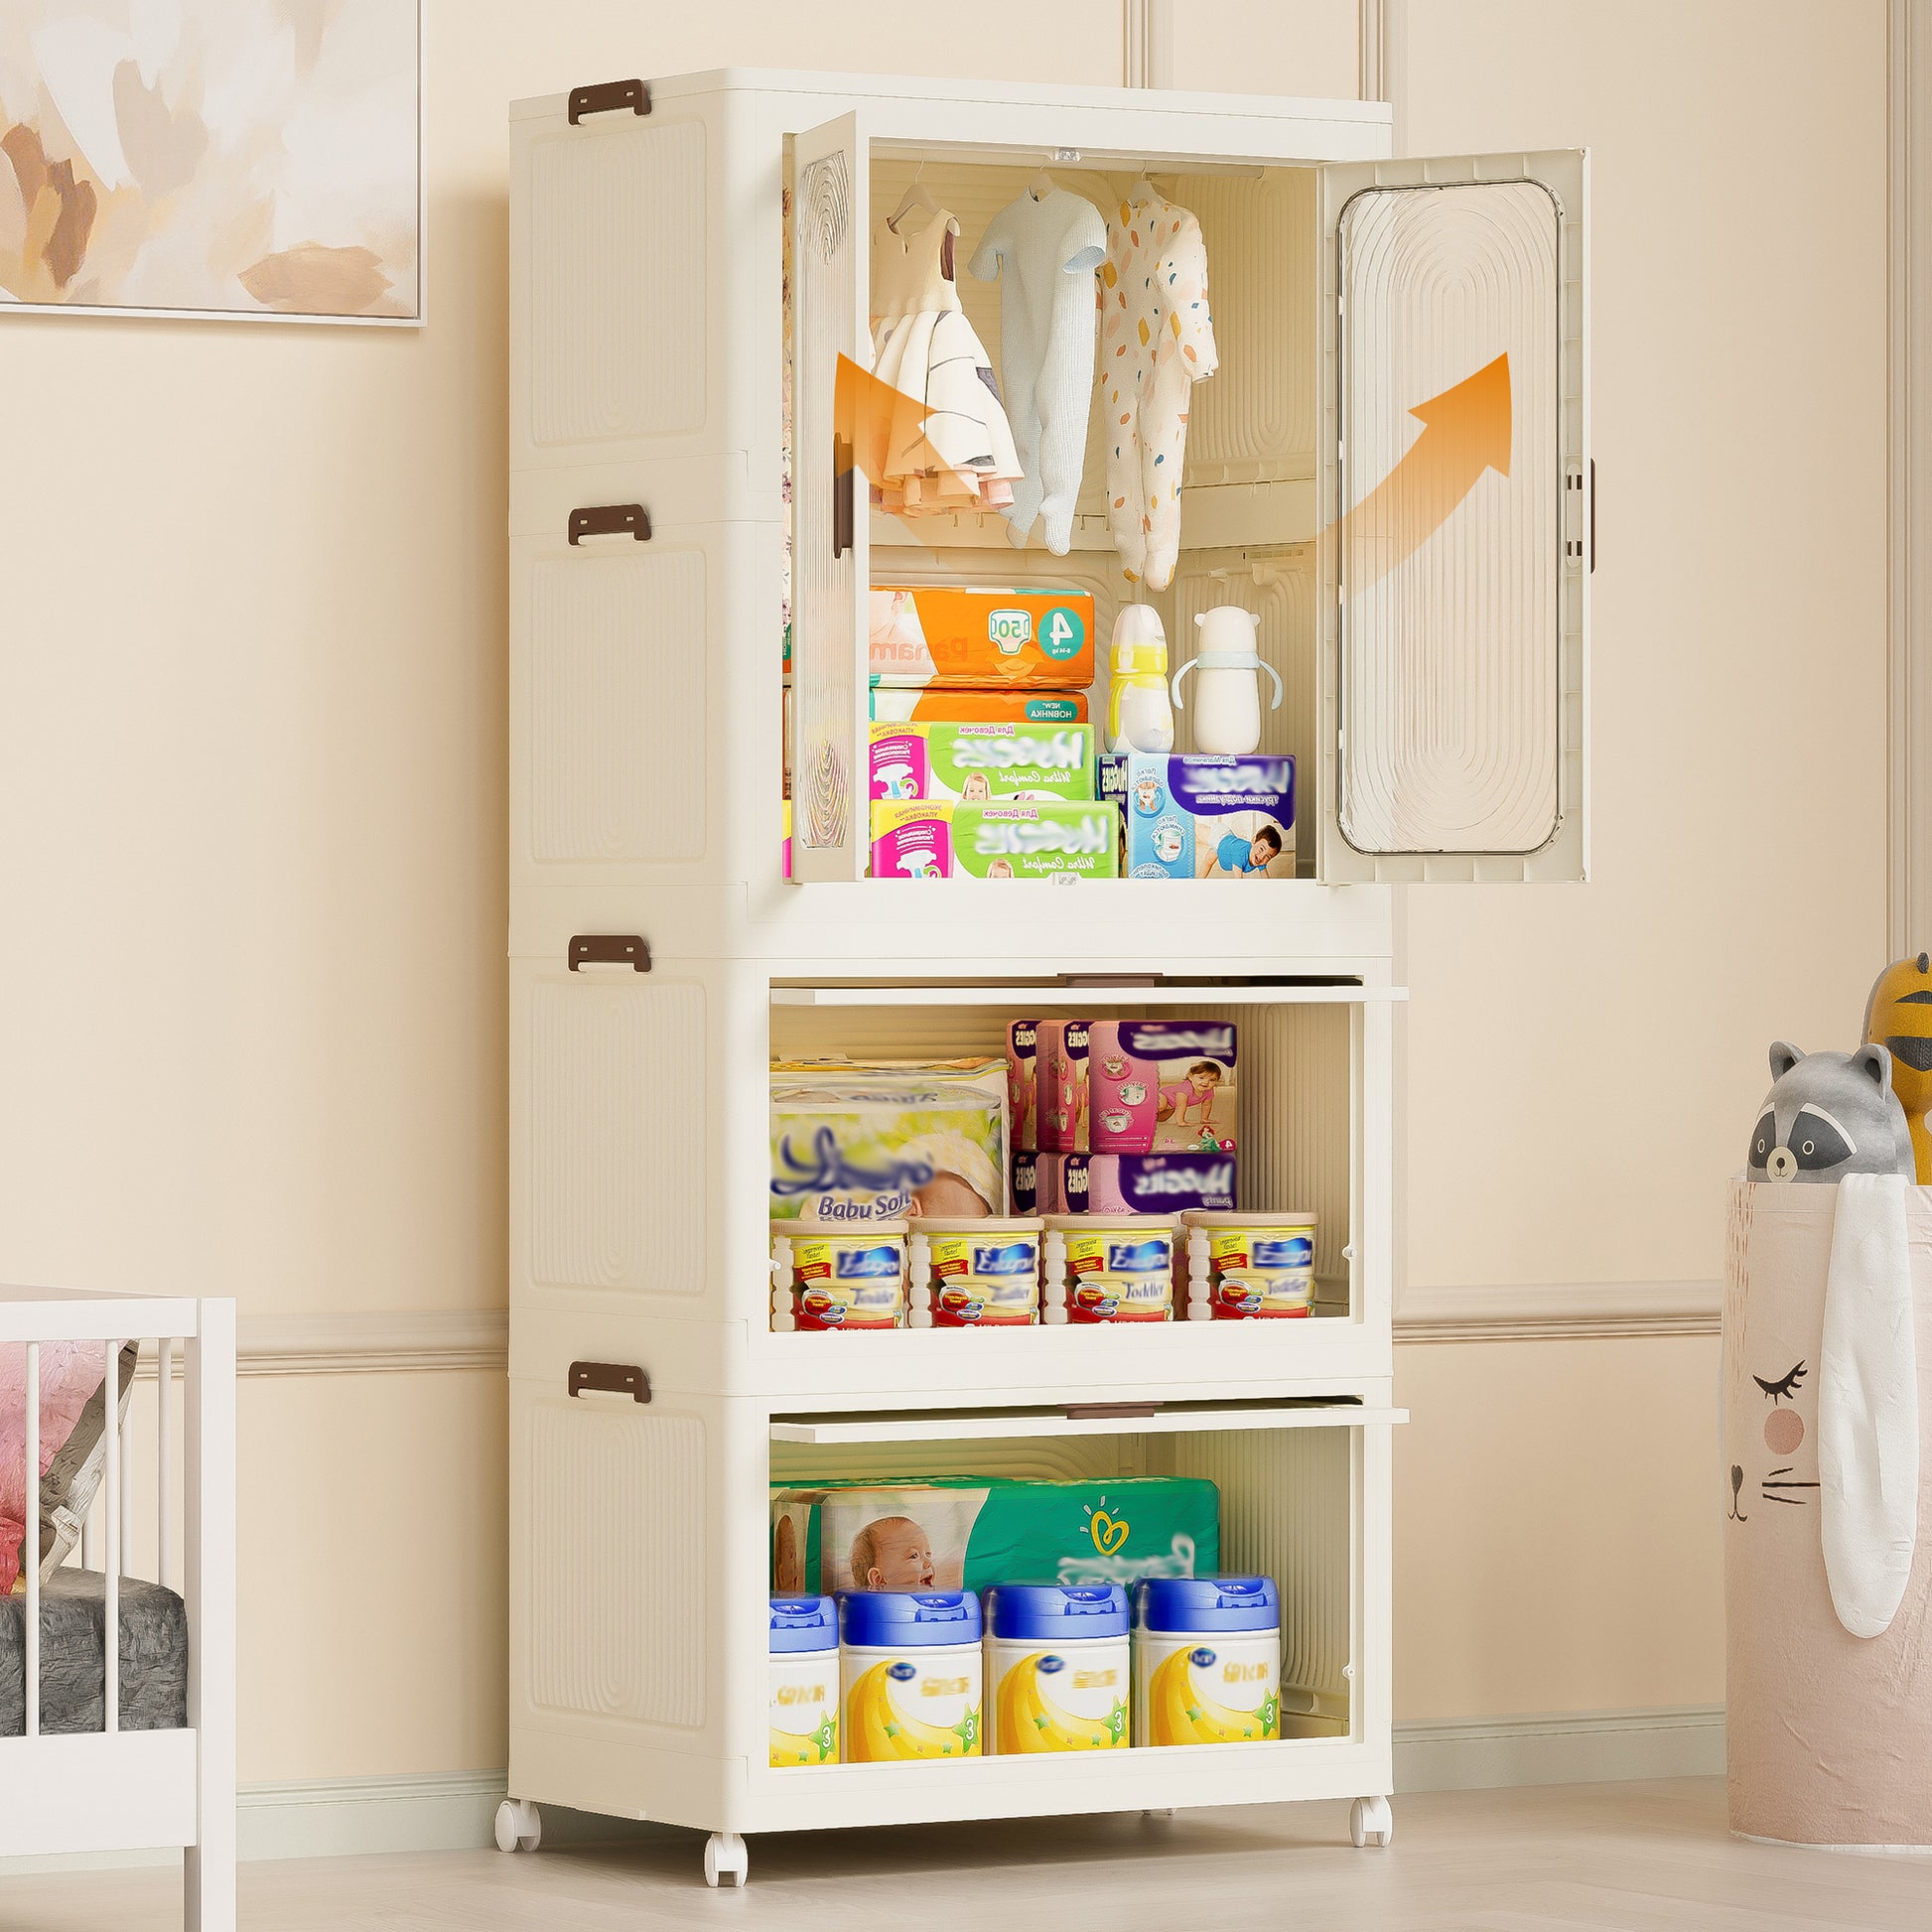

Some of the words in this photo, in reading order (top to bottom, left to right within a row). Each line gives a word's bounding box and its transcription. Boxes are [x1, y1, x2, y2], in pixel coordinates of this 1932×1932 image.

[875, 1189, 911, 1216] Soft
[1122, 1281, 1164, 1299] Toddler
[1114, 1712, 1122, 1732] 3
[1265, 1703, 1274, 1725] 3
[822, 1725, 832, 1748] 3
[965, 1719, 975, 1740] 3
